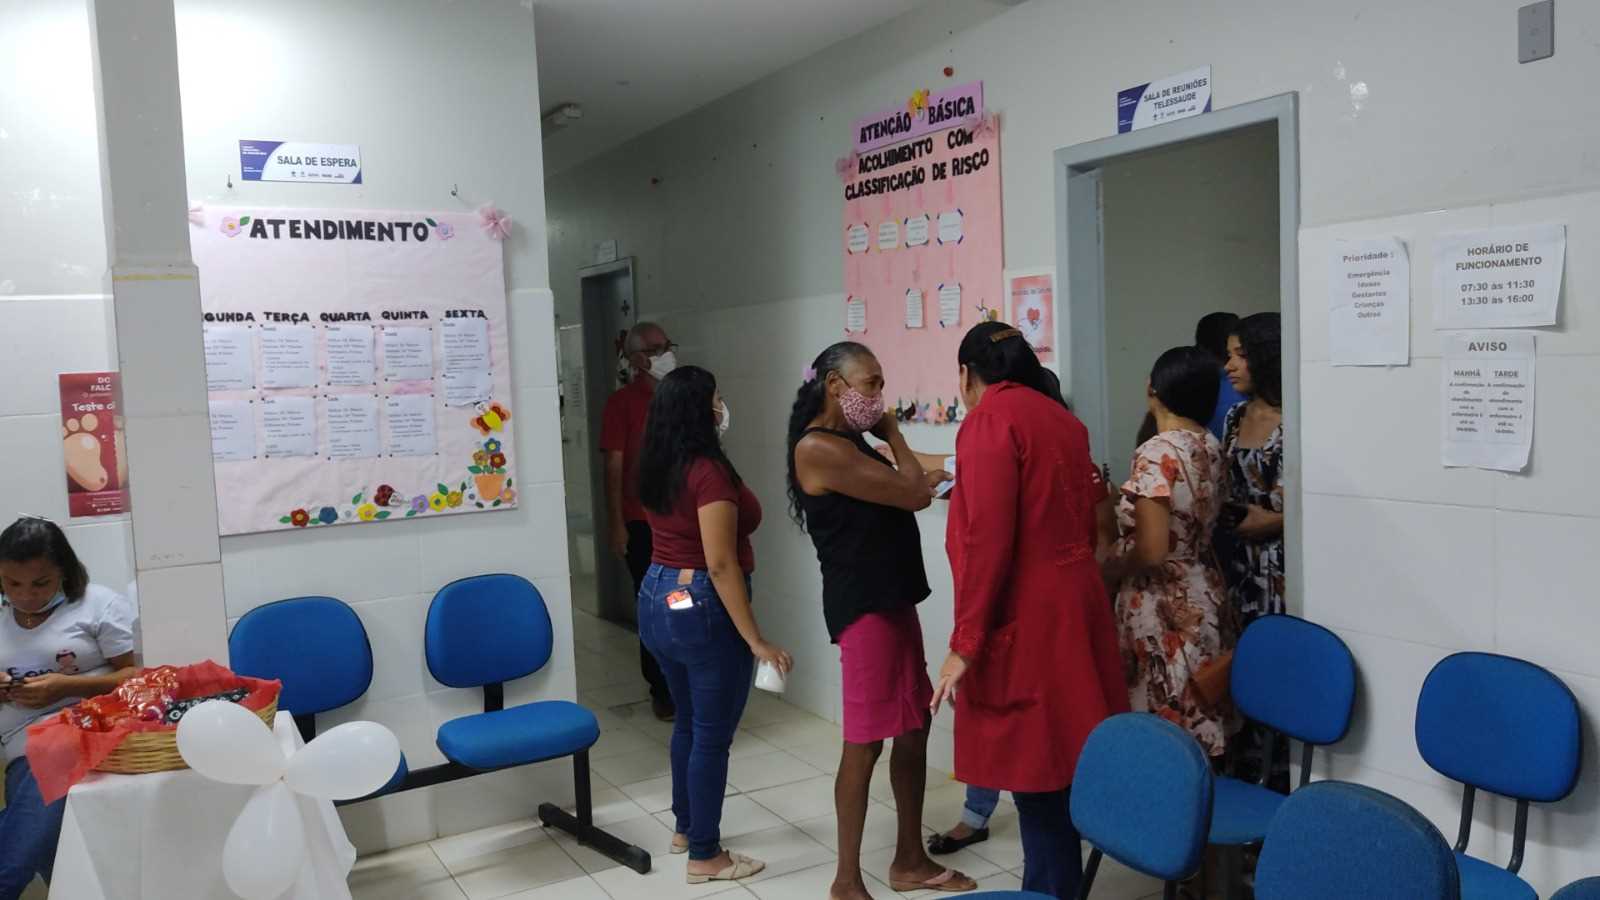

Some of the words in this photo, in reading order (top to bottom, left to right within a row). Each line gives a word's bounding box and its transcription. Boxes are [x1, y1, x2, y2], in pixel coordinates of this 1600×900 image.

[1143, 92, 1160, 102] SALA
[1162, 88, 1171, 97] DE
[859, 112, 912, 144] ATENÇÃO
[928, 96, 976, 125] BÁSICA
[858, 136, 933, 174] ACOLHIMENTO
[947, 128, 974, 149] COM
[277, 155, 302, 165] SALA
[305, 156, 318, 166] DE
[321, 157, 358, 168] ESPERA
[844, 165, 925, 201] CLASSIFICAÇÃO
[932, 162, 947, 181] DE
[952, 148, 989, 176] RISCO
[250, 219, 429, 242] ATENDIMENTO
[1467, 244, 1513, 256] HORÁRIO
[1515, 243, 1529, 252] DE
[1456, 256, 1542, 271] FUNCIONAMENTO
[1460, 282, 1488, 292] 07:30
[1507, 280, 1535, 289] 11:30
[1461, 296, 1488, 306] 13:30
[1507, 294, 1534, 304] 16:00
[202, 312, 256, 323] GUNDA
[263, 311, 310, 325] TERÇA
[319, 311, 371, 322] QUARTA
[381, 310, 429, 320] QUINTA
[445, 310, 486, 319] SEXTA
[1468, 341, 1508, 352] AVISO
[71, 401, 105, 412] Teste
